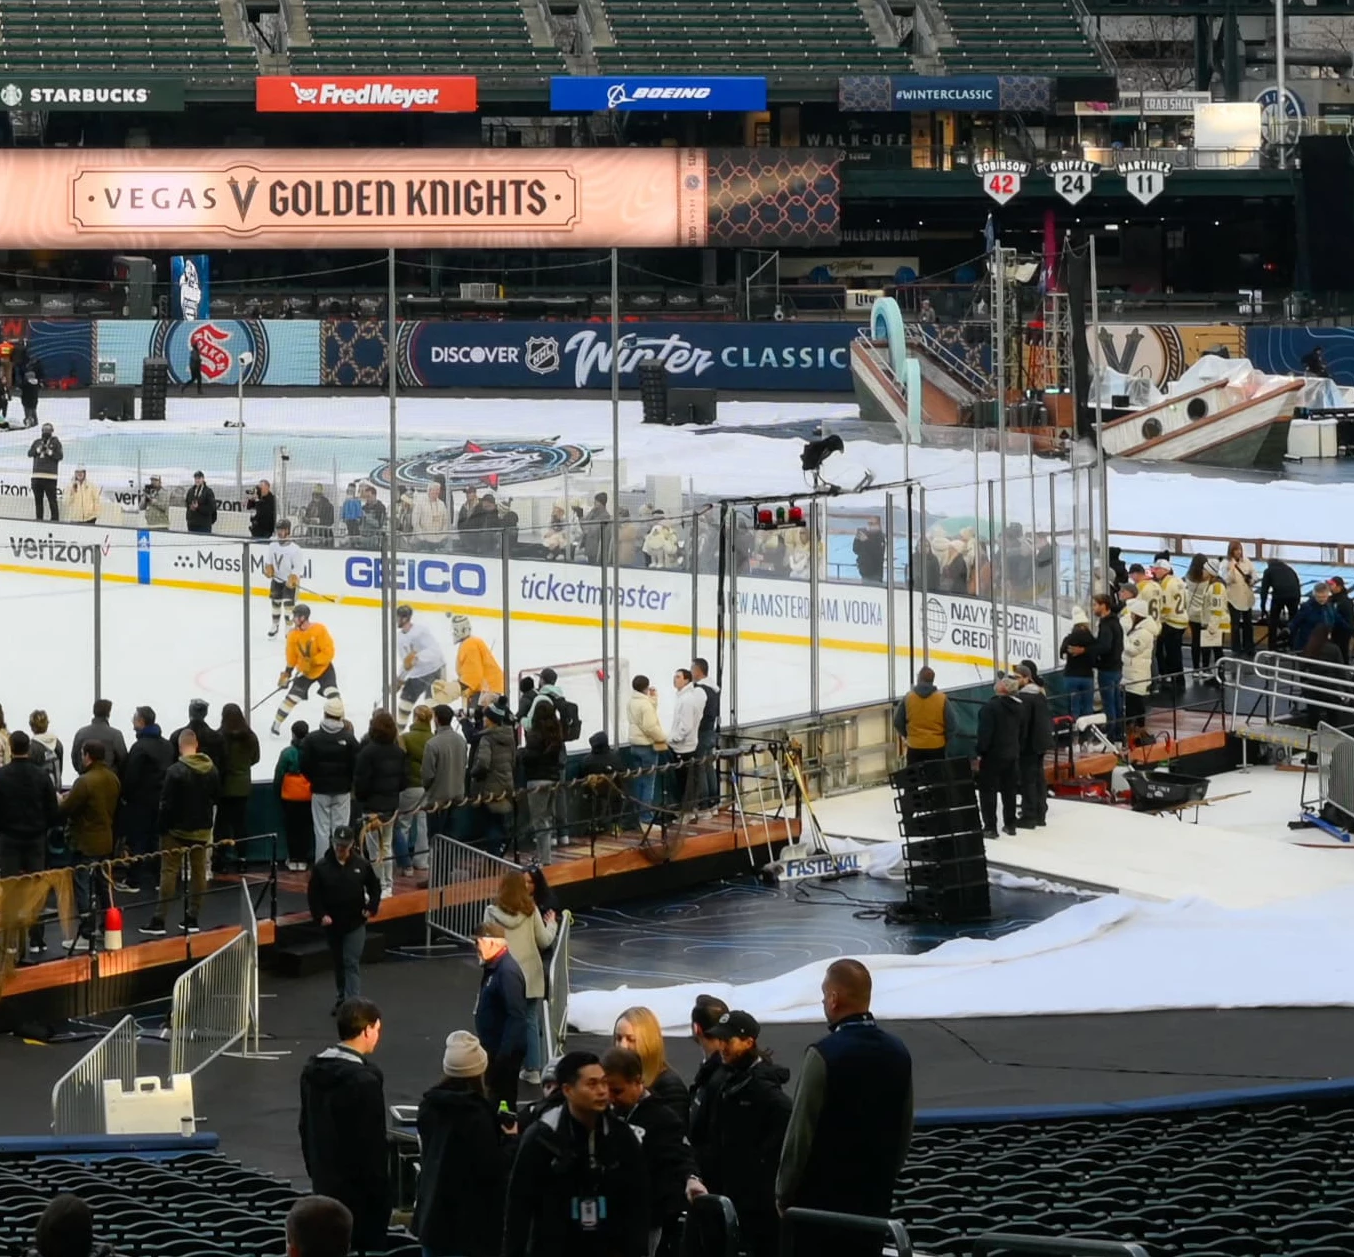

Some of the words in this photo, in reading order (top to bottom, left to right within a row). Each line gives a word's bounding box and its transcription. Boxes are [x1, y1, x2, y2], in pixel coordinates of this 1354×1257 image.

[30, 88, 150, 103] STARBUCKS
[632, 87, 710, 100] BOEING
[895, 89, 992, 101] #WINTERCLASSIC
[1145, 98, 1167, 109] CRAB
[977, 162, 1027, 173] ROBINSON
[1050, 162, 1094, 172] GRIFFEY
[1119, 162, 1170, 173] MARTINEZ
[989, 175, 1013, 194] 42
[1062, 176, 1085, 194] 24
[1137, 176, 1153, 194] 11
[104, 187, 216, 210] VEGAS
[269, 179, 395, 217] GOLDEN
[406, 179, 546, 217] KNIGHTS
[894, 230, 918, 241] BAR
[431, 346, 519, 363] DISCOVER
[721, 346, 846, 369] CLASSIC
[10, 533, 95, 563] verizon
[521, 573, 671, 611] ticketmaster
[752, 594, 839, 623] AMSTERDAM
[843, 599, 882, 626] VODKA
[950, 602, 987, 624] NAVY
[1007, 637, 1042, 660] UNION
[786, 854, 861, 877] FASTENAL
